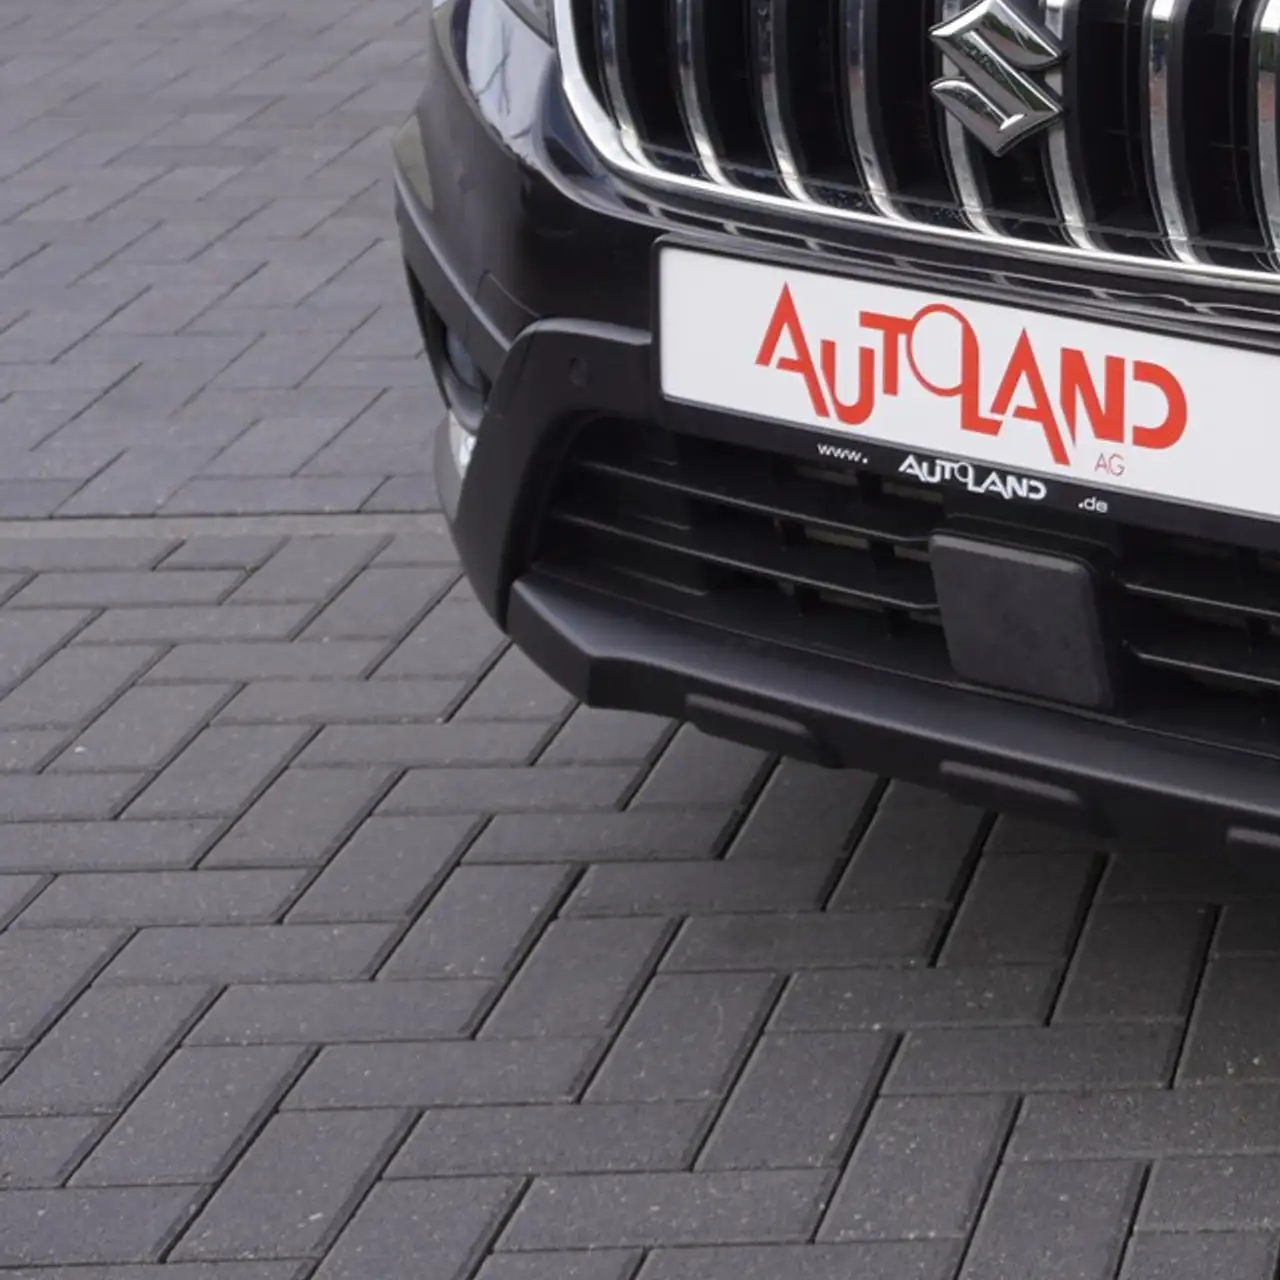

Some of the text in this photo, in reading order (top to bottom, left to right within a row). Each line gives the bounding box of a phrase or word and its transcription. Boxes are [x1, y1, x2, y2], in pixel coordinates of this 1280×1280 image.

[754, 282, 1190, 467] AUTOLAND
[816, 442, 1108, 514] www. AUTOLAND .de
[1094, 452, 1125, 477] AG
